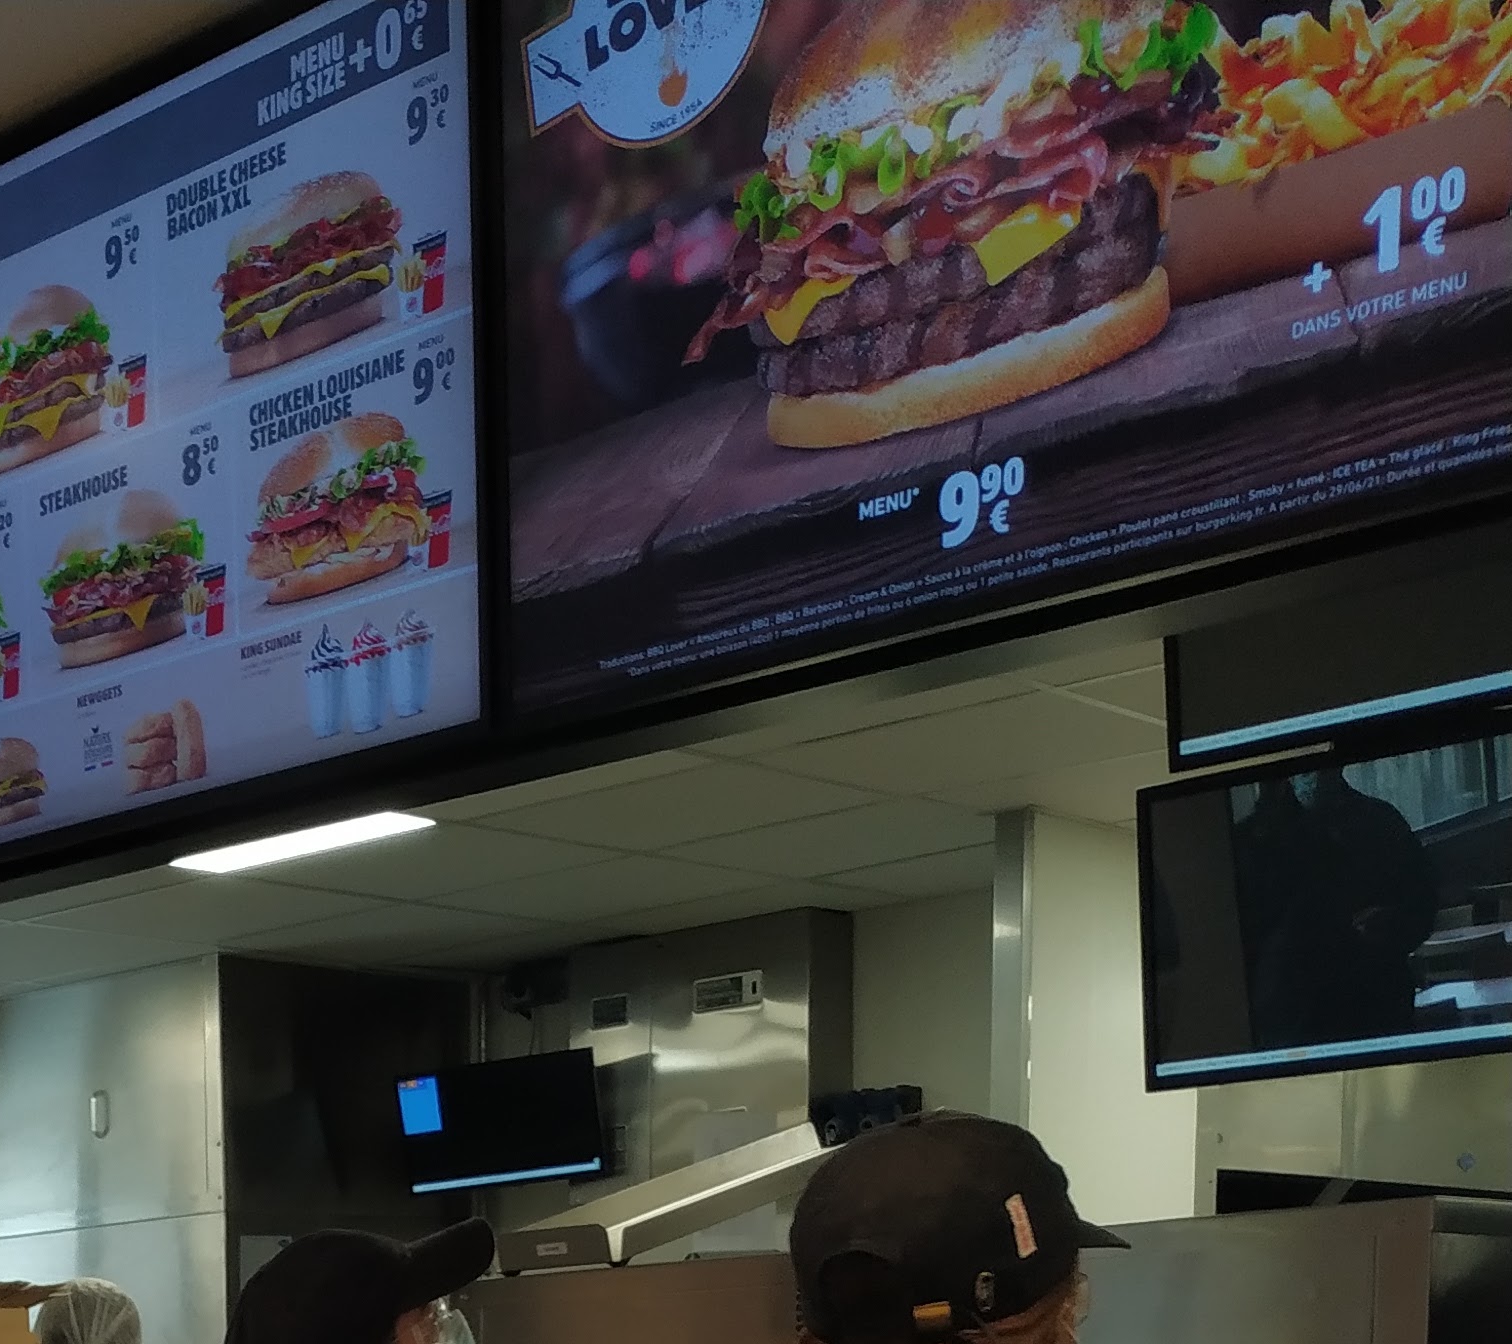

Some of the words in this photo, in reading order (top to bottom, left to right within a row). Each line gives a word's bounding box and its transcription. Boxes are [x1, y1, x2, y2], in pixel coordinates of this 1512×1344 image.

[289, 32, 346, 80] MENU
[585, 0, 710, 72] LOV
[257, 82, 304, 126] KING
[304, 64, 347, 103] SIZE
[649, 113, 678, 133] SINCE
[166, 170, 227, 216] DOUBLE
[229, 142, 287, 191] CHEESE
[167, 199, 218, 241] BACON
[220, 189, 251, 223] XXL
[1292, 310, 1341, 340] DANS
[1346, 291, 1407, 325] VOTRE
[1411, 270, 1469, 302] MENU
[248, 378, 316, 427] CHICKEN
[317, 349, 405, 401] LOUISIANE
[249, 395, 353, 452] STEAKHOUSE
[39, 465, 128, 517] STEAKHOUSE
[240, 639, 264, 661] KING
[264, 630, 303, 654] SUNDAE
